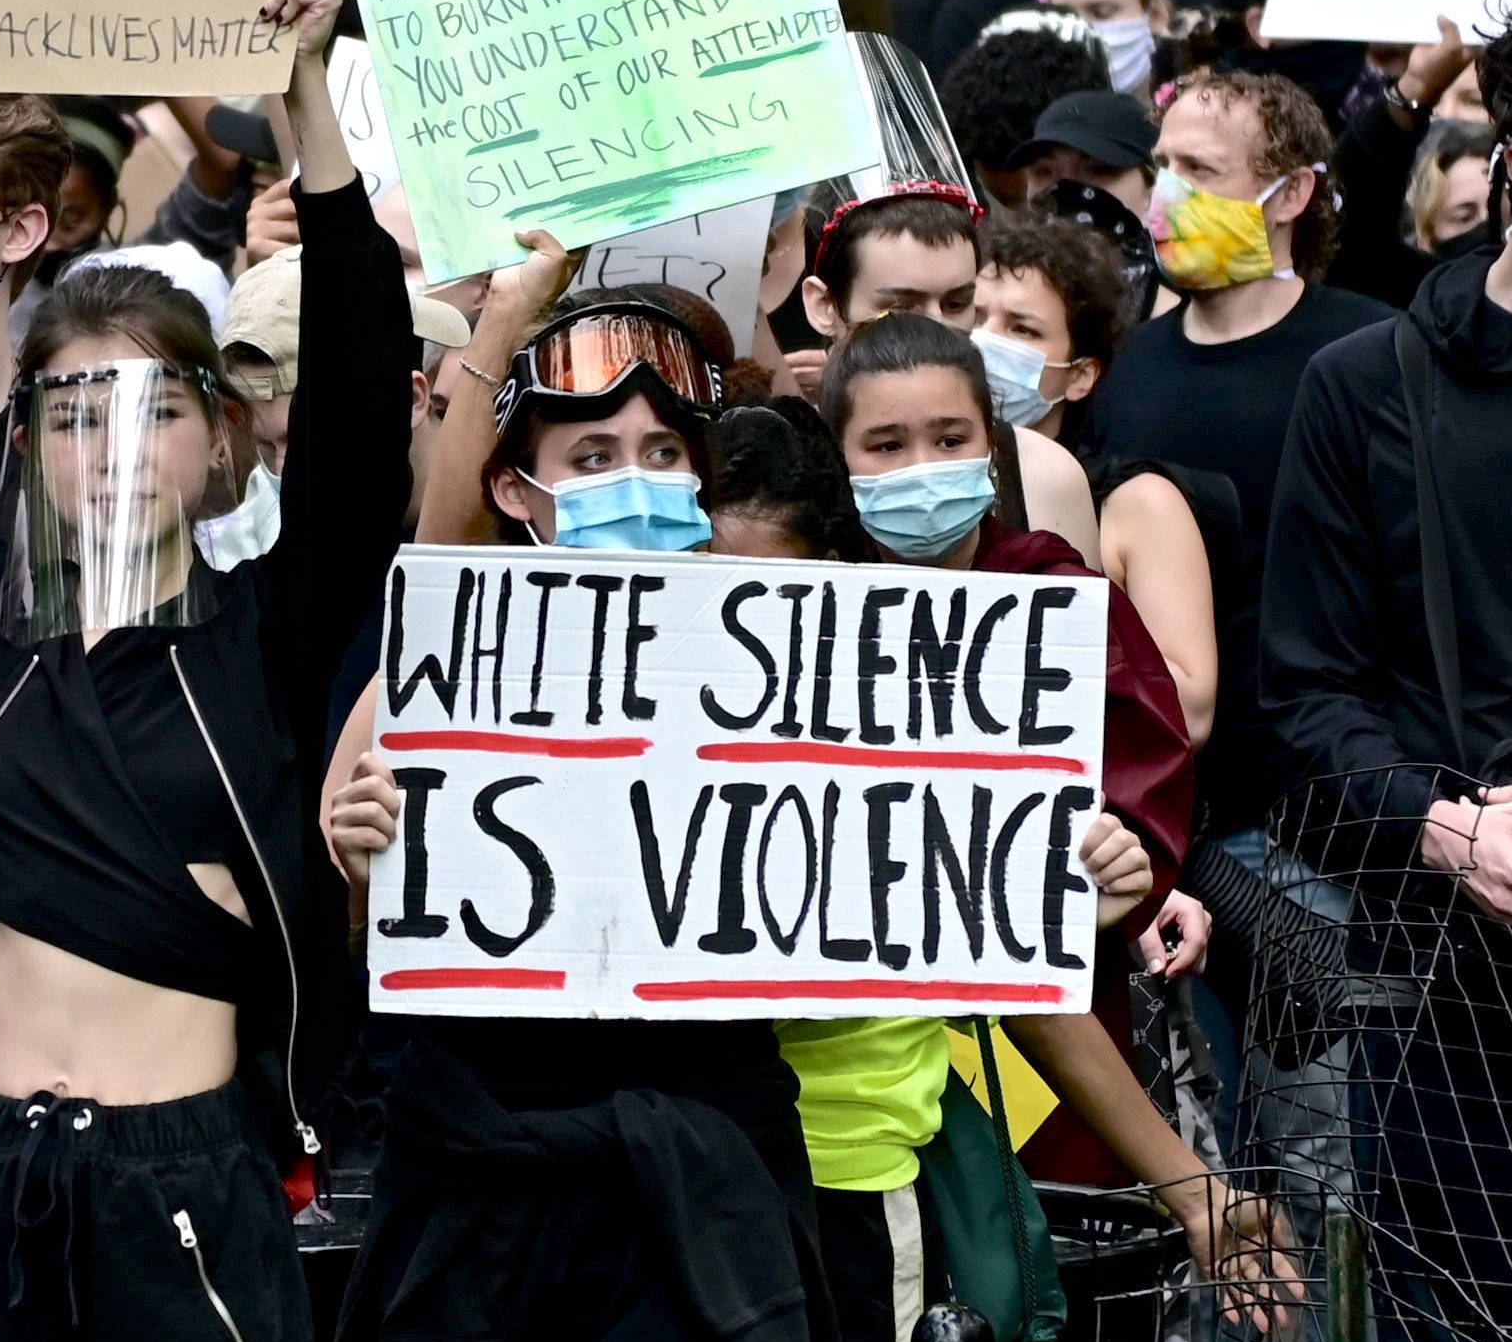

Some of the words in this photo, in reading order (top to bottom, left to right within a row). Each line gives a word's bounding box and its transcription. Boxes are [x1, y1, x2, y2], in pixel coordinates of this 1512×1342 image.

[377, 12, 425, 52] TO
[393, 54, 465, 110] YOU
[406, 113, 458, 149] the
[459, 92, 527, 145] COST
[558, 71, 602, 113] OF
[615, 47, 680, 97] OUR
[465, 90, 791, 210] SILENCING
[385, 563, 667, 727] WHITE
[699, 579, 1084, 747] SILENCE
[376, 767, 557, 959] IS
[629, 777, 1097, 971] VIOLENCE
